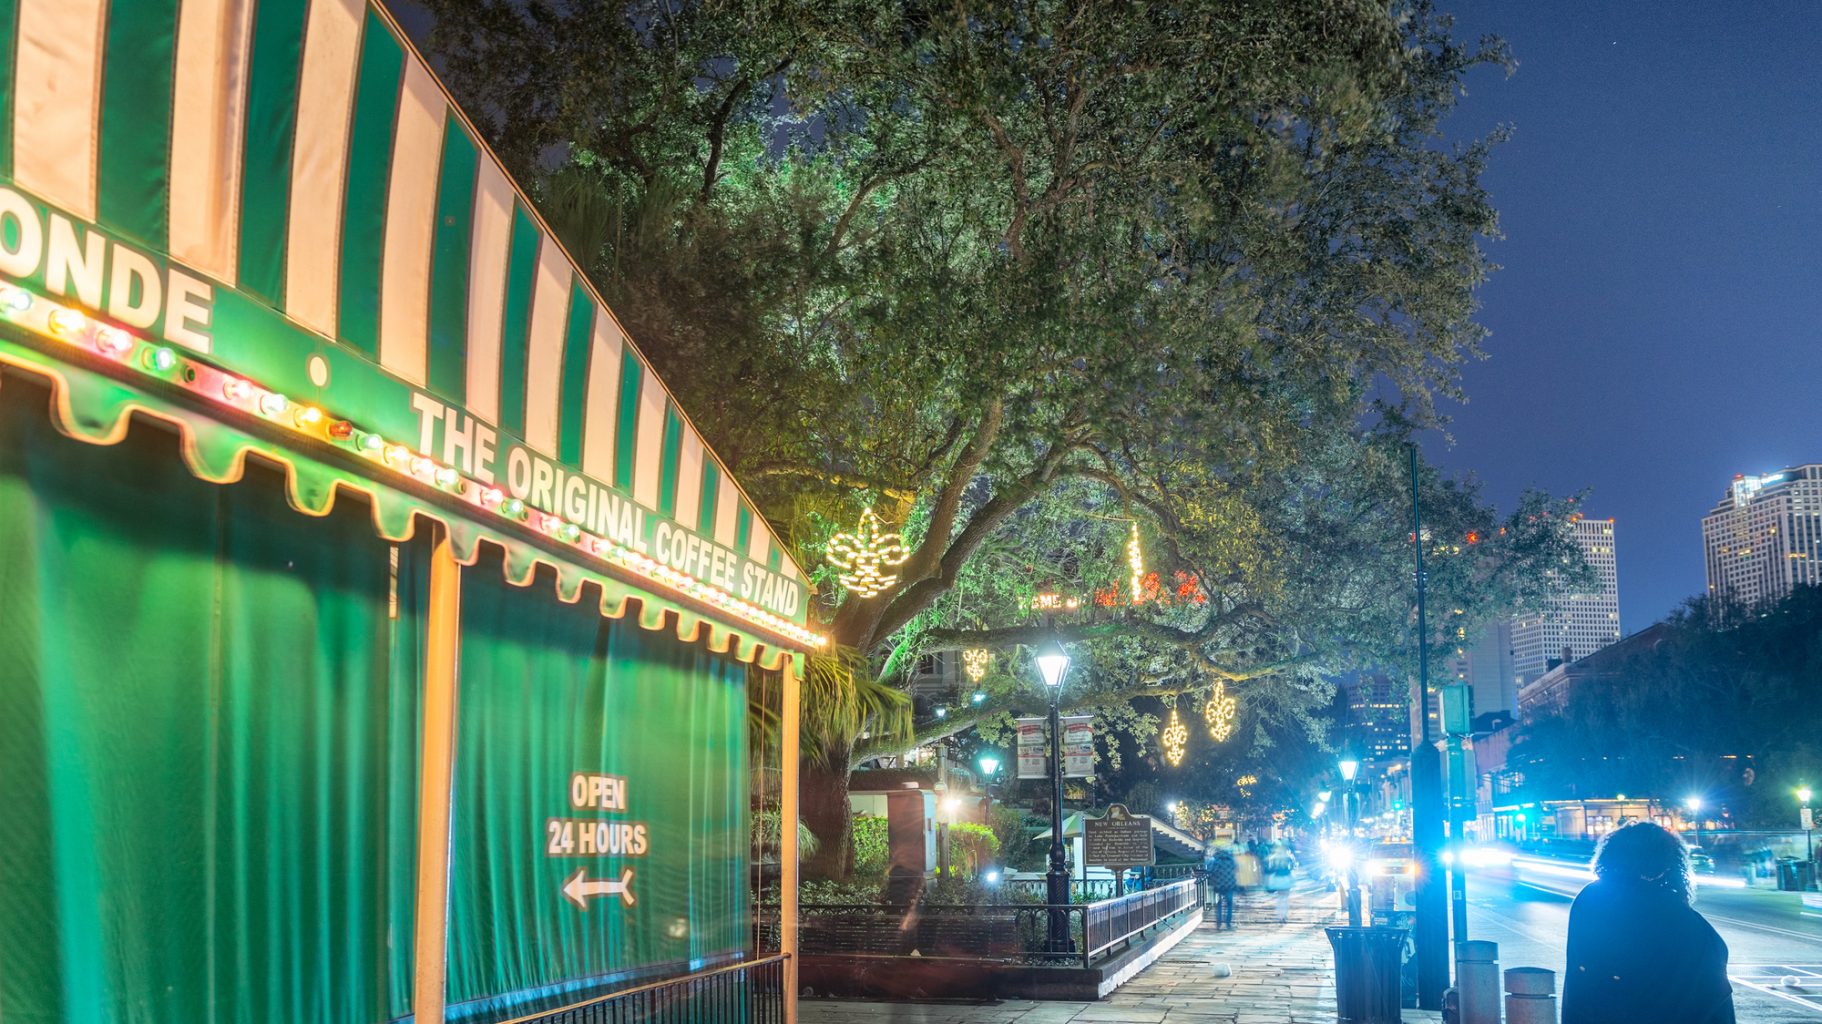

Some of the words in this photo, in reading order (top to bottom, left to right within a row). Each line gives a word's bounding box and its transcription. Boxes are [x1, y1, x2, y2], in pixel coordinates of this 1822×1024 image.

[412, 392, 496, 485] THE
[507, 446, 648, 554] ORIGINAL
[655, 523, 737, 593] COFFEE
[741, 561, 799, 618] STAND
[572, 774, 625, 810] OPEN
[548, 821, 575, 854] 24
[579, 822, 647, 855] HOURS
